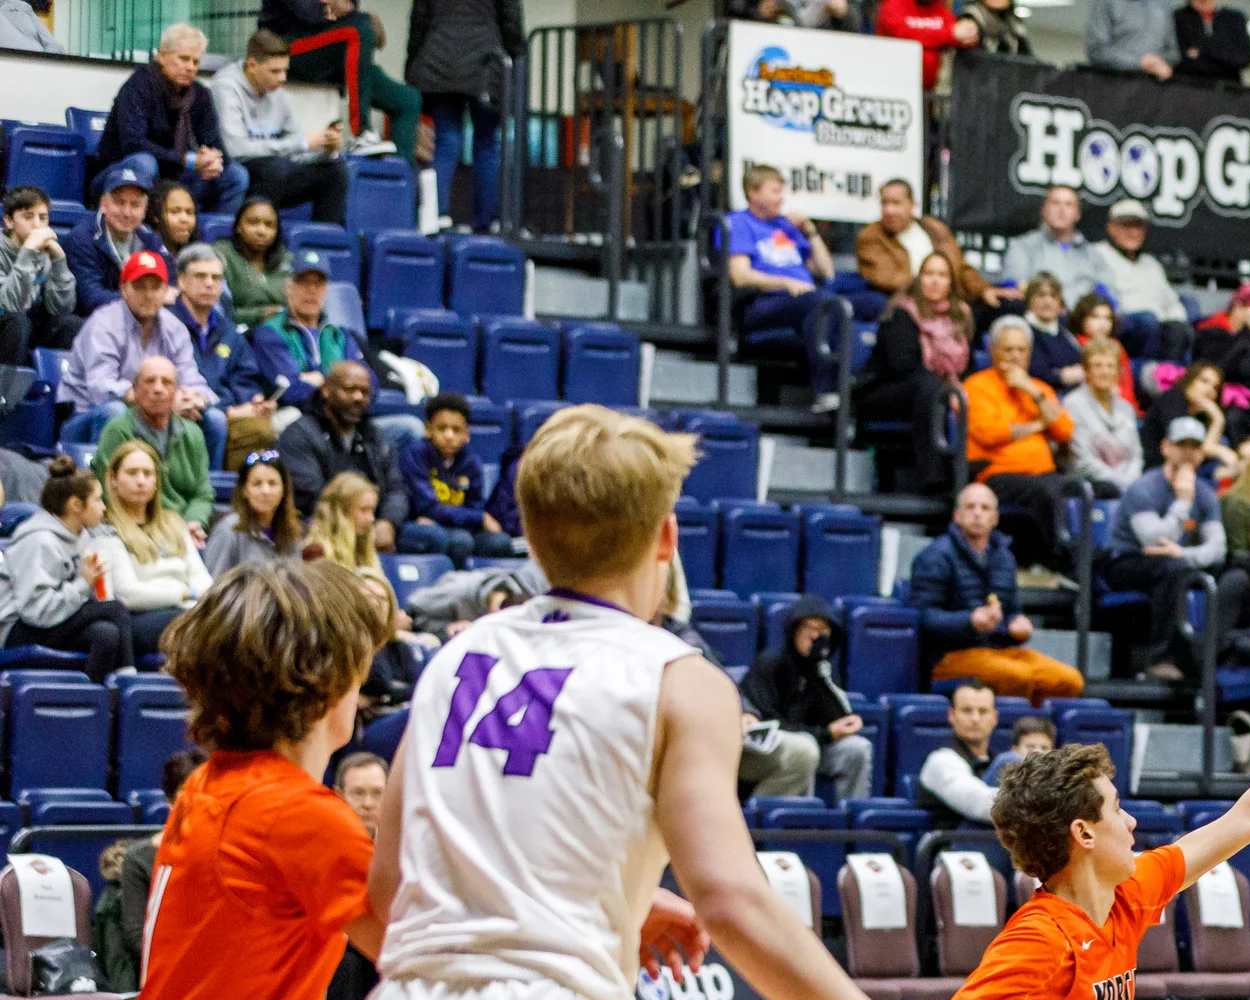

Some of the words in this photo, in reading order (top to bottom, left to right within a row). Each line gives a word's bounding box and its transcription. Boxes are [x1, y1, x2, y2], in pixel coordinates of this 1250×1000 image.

[821, 86, 913, 134] Group
[1017, 102, 1200, 217] Hoop
[430, 651, 577, 778] 14
